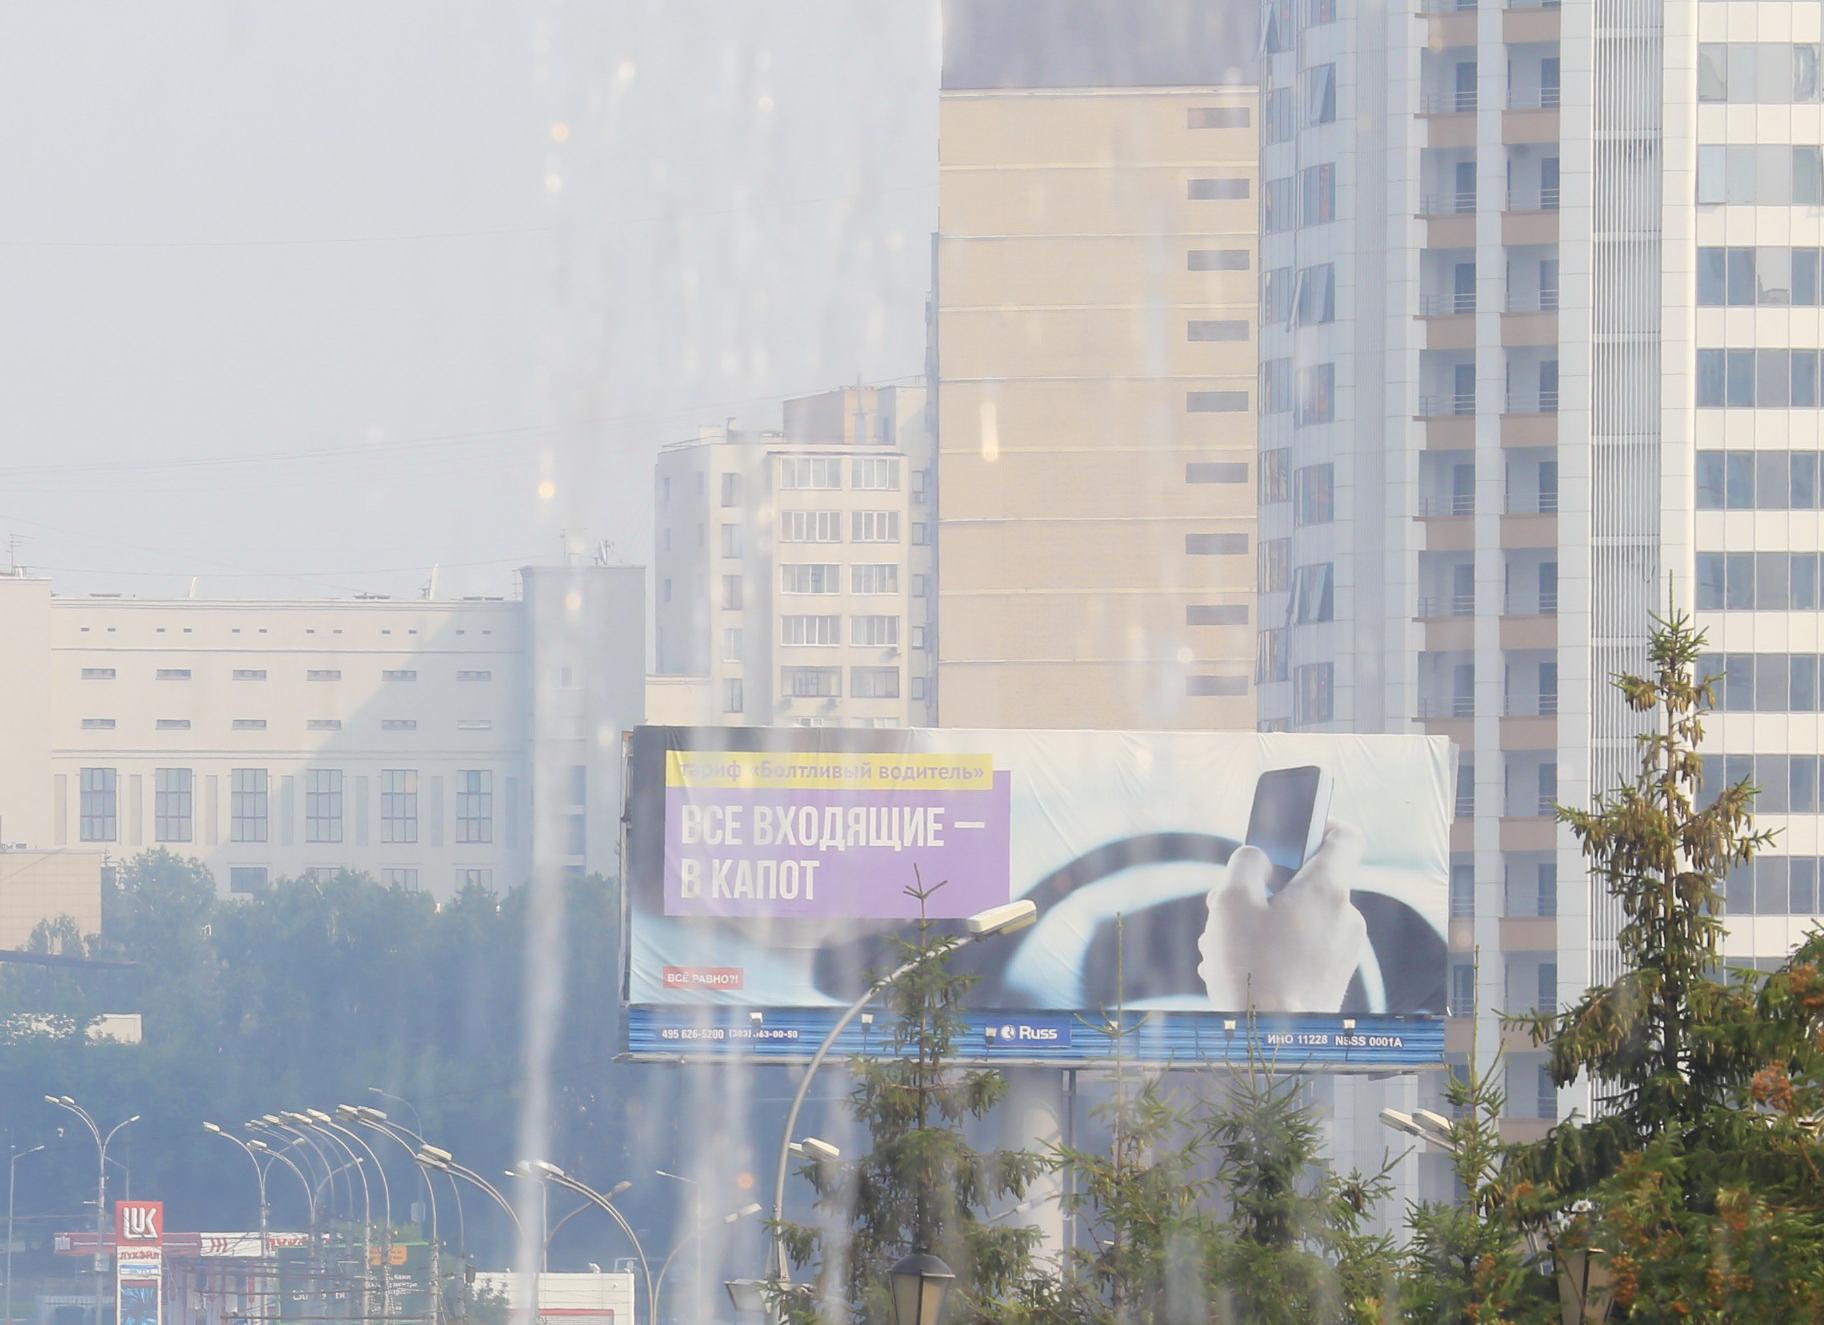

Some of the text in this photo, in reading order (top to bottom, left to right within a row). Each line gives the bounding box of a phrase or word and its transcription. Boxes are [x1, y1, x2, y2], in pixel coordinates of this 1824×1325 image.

[682, 760, 984, 781] тариф «Болтливый водитель»
[681, 805, 743, 846] ВСЕ
[753, 805, 945, 852] ВХОДЯЩИЕ
[681, 858, 821, 900] В КАПОТ
[667, 972, 738, 984] ВСЁ РАВНО?!
[662, 1030, 679, 1039] 495
[681, 1029, 724, 1040] 626-5200
[753, 1030, 798, 1039] 63-00-50
[1019, 1025, 1058, 1040] Russ
[1297, 1034, 1328, 1045] 11228
